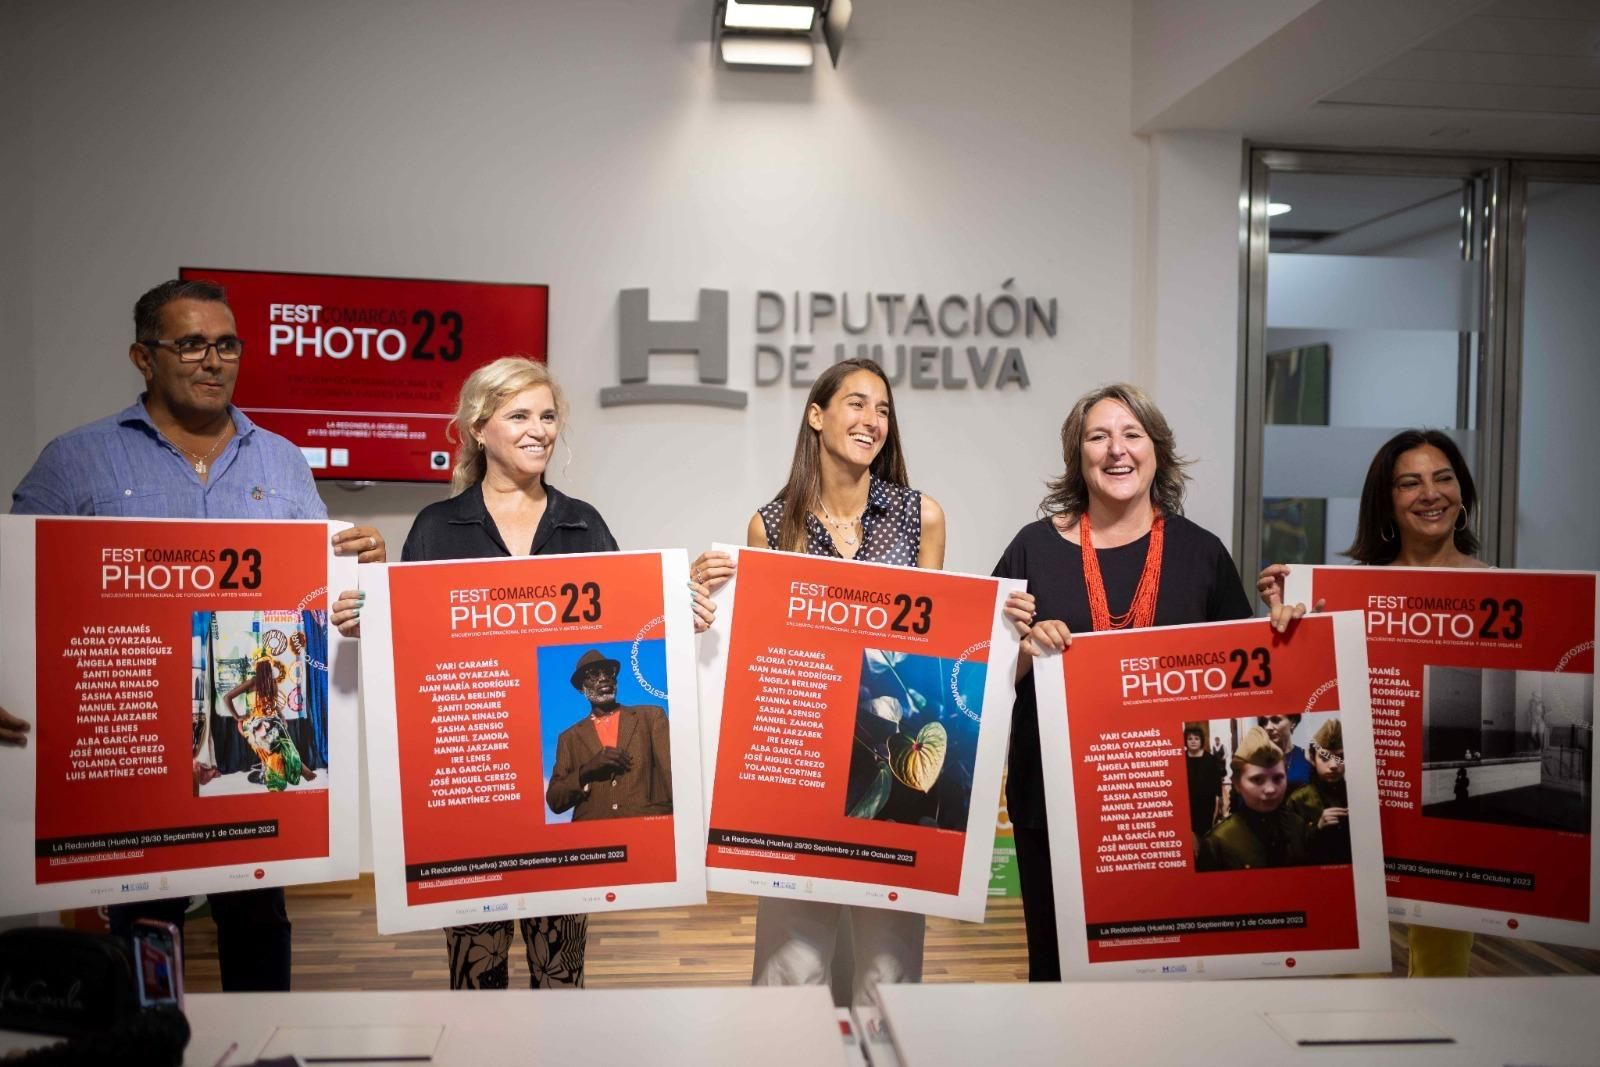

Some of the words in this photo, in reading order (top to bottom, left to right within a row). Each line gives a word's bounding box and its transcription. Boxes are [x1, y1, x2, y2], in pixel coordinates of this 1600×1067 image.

[754, 278, 1058, 338] DIPUTACIÓN
[269, 323, 407, 361] PHOTO
[411, 309, 463, 362] 23
[754, 344, 814, 389] DE
[102, 565, 214, 589] PHOTO
[219, 548, 261, 589] 23
[451, 600, 556, 630] PHOTO
[560, 581, 601, 623] 23
[788, 596, 888, 629] PHOTO
[890, 593, 933, 635] 23
[1368, 610, 1473, 637] PHOTO
[1478, 598, 1523, 640] 23
[83, 626, 105, 634] VARI
[108, 636, 162, 644] OYARZABAL
[63, 648, 86, 656] JUAN
[116, 658, 157, 666] BERLINDE
[436, 662, 456, 670] VARI
[83, 670, 109, 678] SANTI
[112, 669, 152, 678] DONAIRE
[748, 665, 768, 673] JUAN
[1122, 666, 1226, 697] PHOTO
[1229, 646, 1272, 689] 23
[425, 673, 457, 682] GLORIA
[459, 670, 510, 680] OYARZABAL
[75, 681, 117, 690] ARIANNA
[120, 680, 159, 688] RINALDO
[82, 692, 112, 701] SASHA
[115, 691, 153, 699] ASENSIO
[468, 691, 506, 700] BERLINDE
[1372, 687, 1420, 698] RODRÍGUEZ
[79, 703, 116, 712] MANUEL
[119, 702, 158, 710] ZAMORA
[438, 704, 462, 712] SANTI
[464, 701, 501, 710] DONAIRE
[77, 714, 110, 723] HANNA
[112, 712, 157, 722] JARZABEK
[431, 714, 470, 723] ARIANNA
[472, 711, 509, 720] RINALDO
[112, 724, 138, 733] LENES
[438, 725, 466, 733] SASHA
[468, 722, 503, 731] ASENSIO
[76, 737, 100, 746] ALBA
[436, 735, 469, 744] MANUEL
[472, 732, 509, 741] ZAMORA
[94, 747, 128, 756] MIGUEL
[130, 745, 165, 754] CEREZO
[434, 746, 465, 754] HANNA
[466, 742, 509, 752] JARZABEK
[751, 744, 770, 752] ALBA
[804, 750, 820, 758] FIJO
[1090, 743, 1120, 752] GLORIA
[1122, 739, 1172, 749] OYARZABAL
[72, 758, 117, 768] YOLANDA
[119, 755, 163, 765] CORTINES
[466, 754, 491, 762] LENES
[764, 755, 792, 764] MIGUEL
[794, 759, 824, 768] CEREZO
[1084, 754, 1105, 762] JUAN
[1131, 760, 1168, 769] BERLINDE
[66, 771, 86, 780] LUIS
[137, 766, 167, 775] CONDE
[435, 767, 457, 775] ALBA
[745, 763, 782, 773] YOLANDA
[784, 768, 821, 778] CORTINES
[1103, 773, 1127, 781] SANTI
[1128, 770, 1164, 779] DONAIRE
[1388, 770, 1405, 778] FIJO
[452, 776, 482, 784] MIGUEL
[484, 773, 517, 782] CEREZO
[799, 779, 825, 788] CONDE
[1379, 779, 1411, 788] CEREZO
[432, 786, 473, 796] YOLANDA
[475, 783, 515, 793] CORTINES
[1097, 783, 1134, 792] ARIANNA
[1136, 780, 1172, 789] RINALDO
[428, 799, 446, 807] LUIS
[492, 793, 520, 802] CONDE
[1103, 793, 1130, 802] SASHA
[1132, 790, 1168, 799] ASENSIO
[1102, 803, 1135, 812] MANUEL
[1137, 800, 1173, 809] ZAMORA
[1385, 800, 1414, 809] CONDE
[1132, 810, 1173, 820] JARZABEK
[1132, 822, 1156, 830] LENES
[1118, 843, 1148, 851] MIGUEL
[1150, 840, 1182, 849] CEREZO
[1100, 853, 1139, 862] YOLANDA
[1141, 850, 1181, 859] CORTINES
[431, 865, 468, 874] Redondela
[1096, 865, 1113, 873] LUIS
[1158, 860, 1186, 868] CONDE
